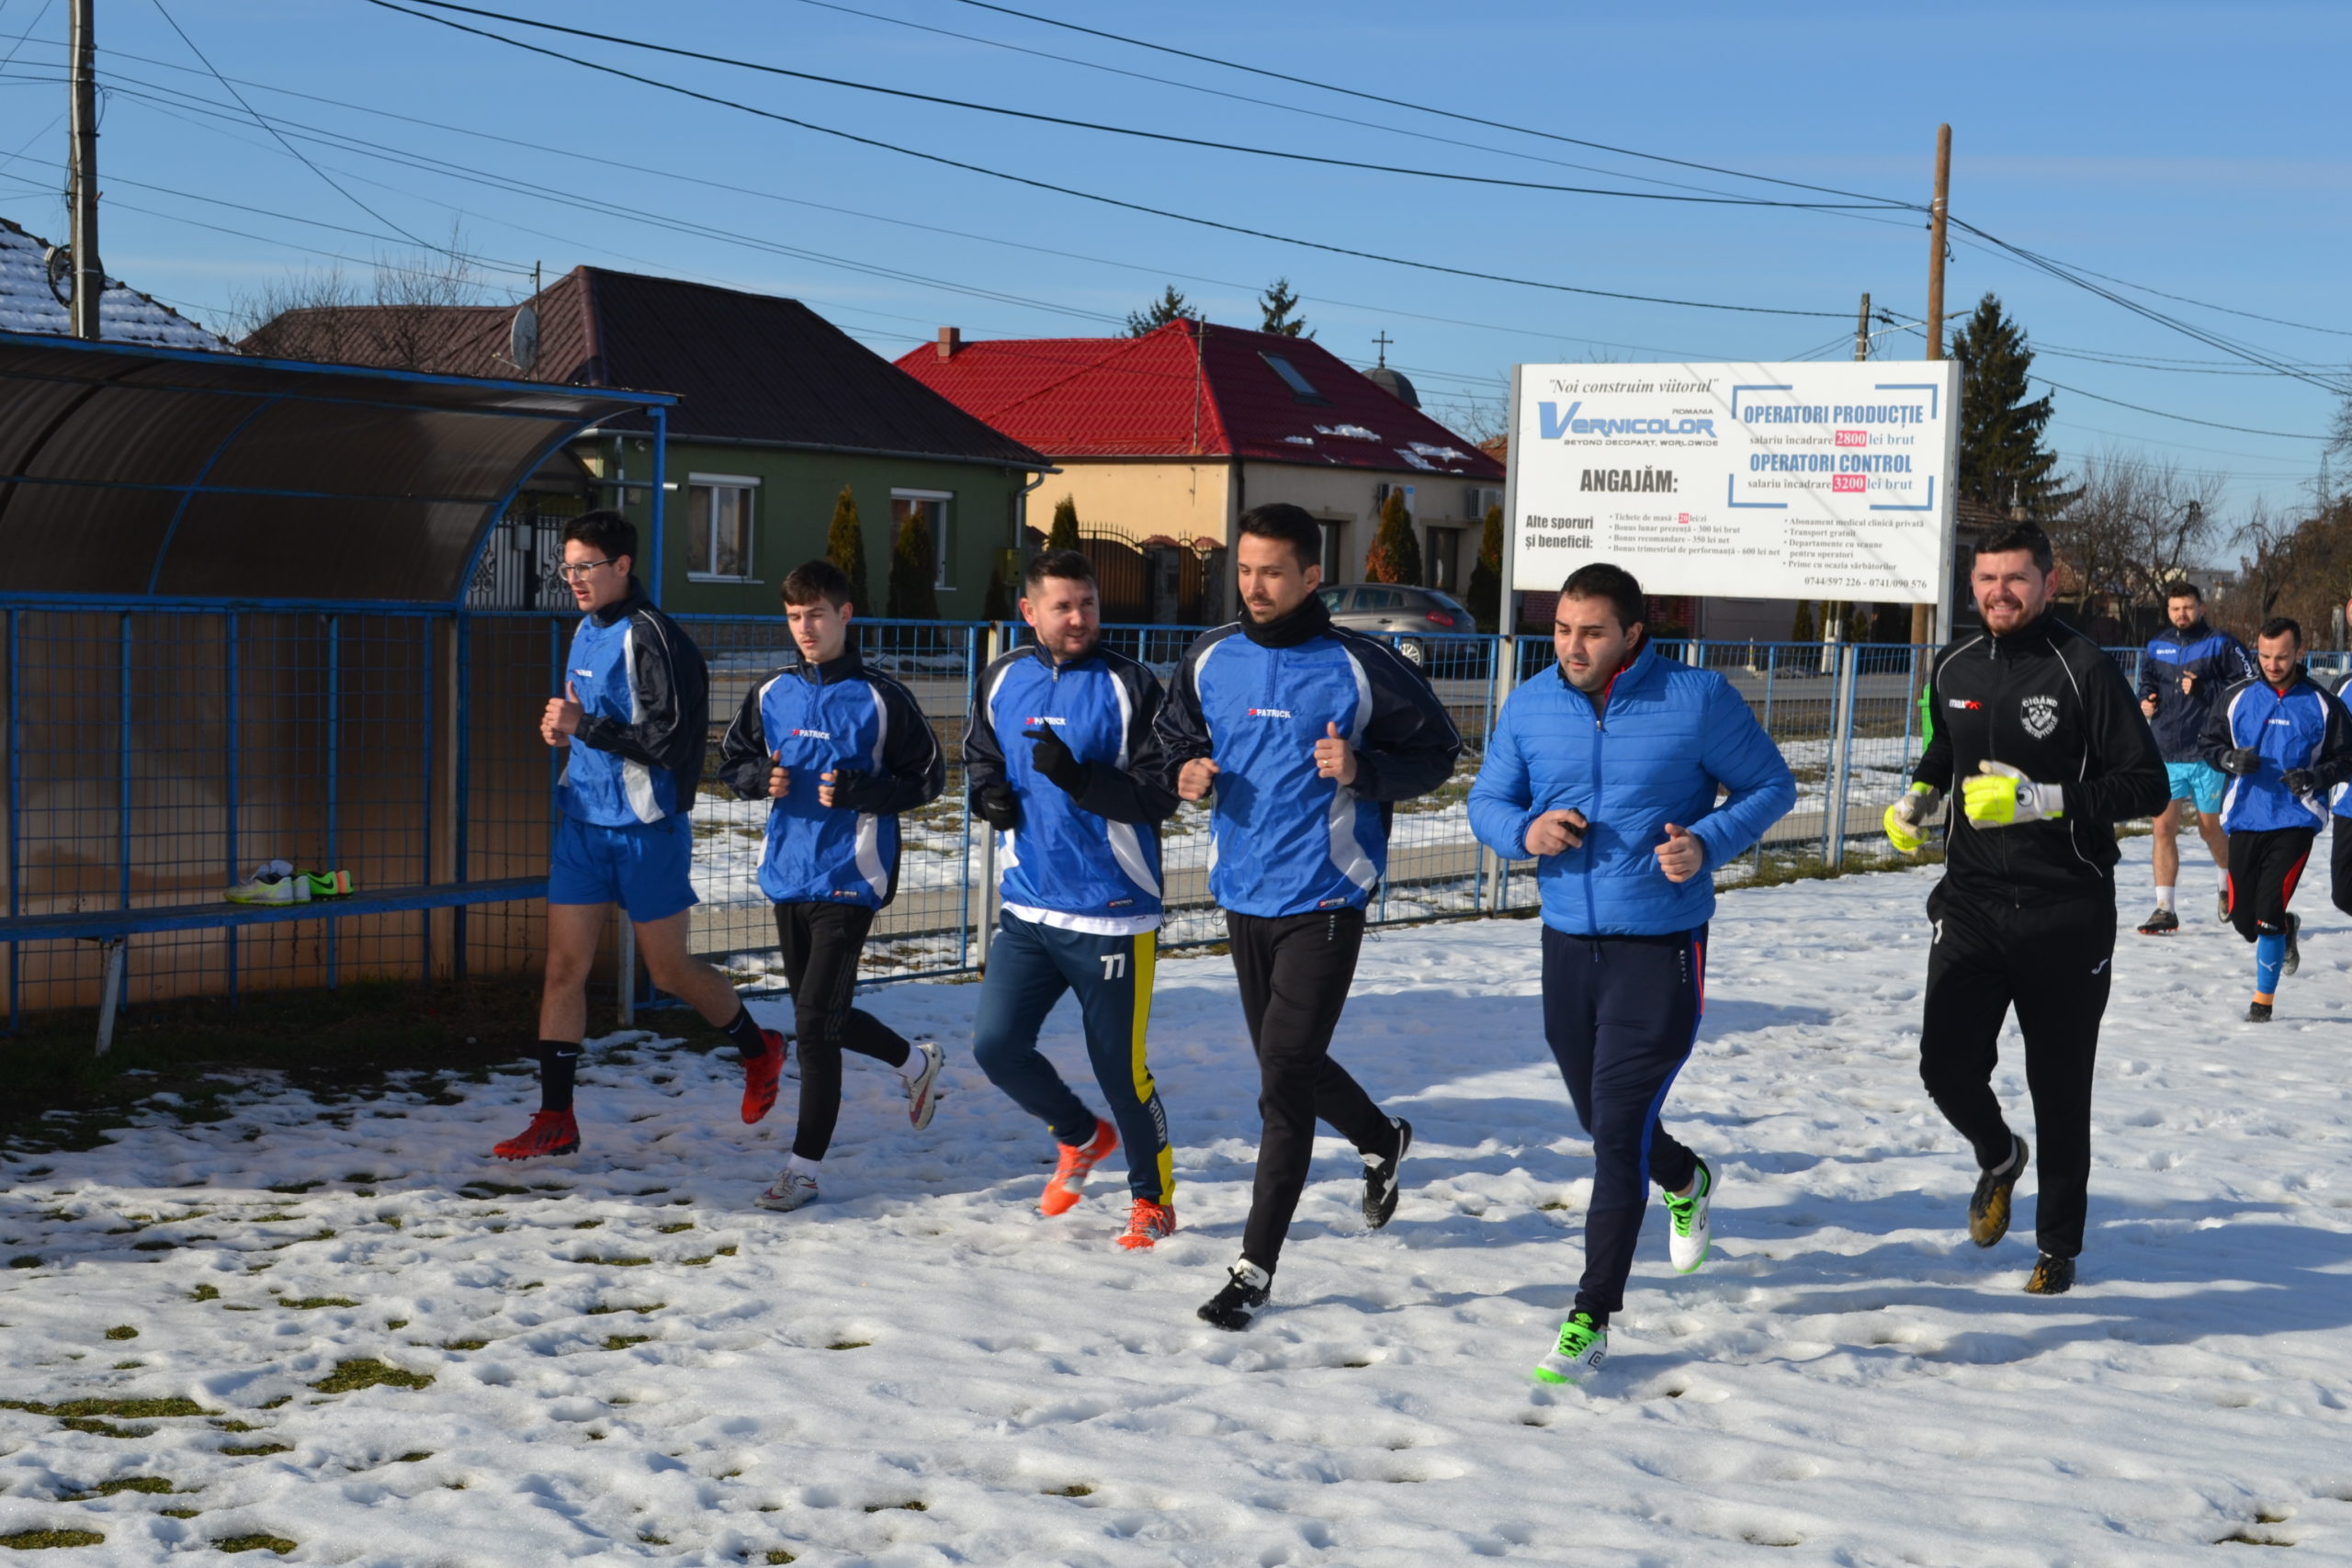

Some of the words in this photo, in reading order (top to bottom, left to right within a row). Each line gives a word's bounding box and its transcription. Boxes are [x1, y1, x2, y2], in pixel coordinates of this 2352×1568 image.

[1582, 378, 1654, 393] construim
[1744, 405, 1829, 423] OPERATORI
[1832, 404, 1924, 428] PRODUCȚIE
[1749, 434, 1783, 446] salariu
[1785, 434, 1834, 446] încadrare
[1837, 432, 1866, 446] 2800
[1869, 434, 1883, 446] lei
[1887, 434, 1915, 446] brut
[1749, 453, 1836, 472] OPERATORI
[1839, 454, 1913, 473] CONTROL
[1579, 465, 1679, 493] ANGAJĂM:
[1747, 479, 1781, 490] salariu
[1783, 479, 1832, 490] încadrare
[1834, 476, 1864, 490] 3200
[1867, 478, 1882, 490] lei
[1885, 478, 1913, 491] brut
[1525, 514, 1548, 529] Alte
[1551, 515, 1594, 530] sporuri
[1615, 513, 1641, 522] Tichete
[1642, 513, 1652, 522] de
[1790, 517, 1834, 526] Abonament
[1836, 518, 1866, 527] medical
[1638, 524, 1657, 532] lunar
[1713, 525, 1722, 533] lei
[1724, 525, 1740, 533] brut
[1791, 527, 1827, 537] Transport
[1538, 534, 1593, 549] beneficii:
[1614, 534, 1636, 542] Bonus
[1638, 535, 1685, 543] recomandare
[1789, 538, 1843, 548] Departamente
[1613, 544, 1635, 552] Bonus
[1637, 545, 1677, 553] trimestrial
[1757, 547, 1767, 556] lei
[1790, 550, 1815, 559] pentru
[1817, 551, 1854, 560] operatori
[1788, 559, 1812, 568] Prime
[1824, 561, 1849, 570] ocazia
[1804, 577, 1843, 586] 0744/597
[1845, 578, 1861, 587] 226
[1911, 581, 1928, 589] 576
[1257, 708, 1292, 718] PATRICK
[799, 729, 831, 740] PATRICK
